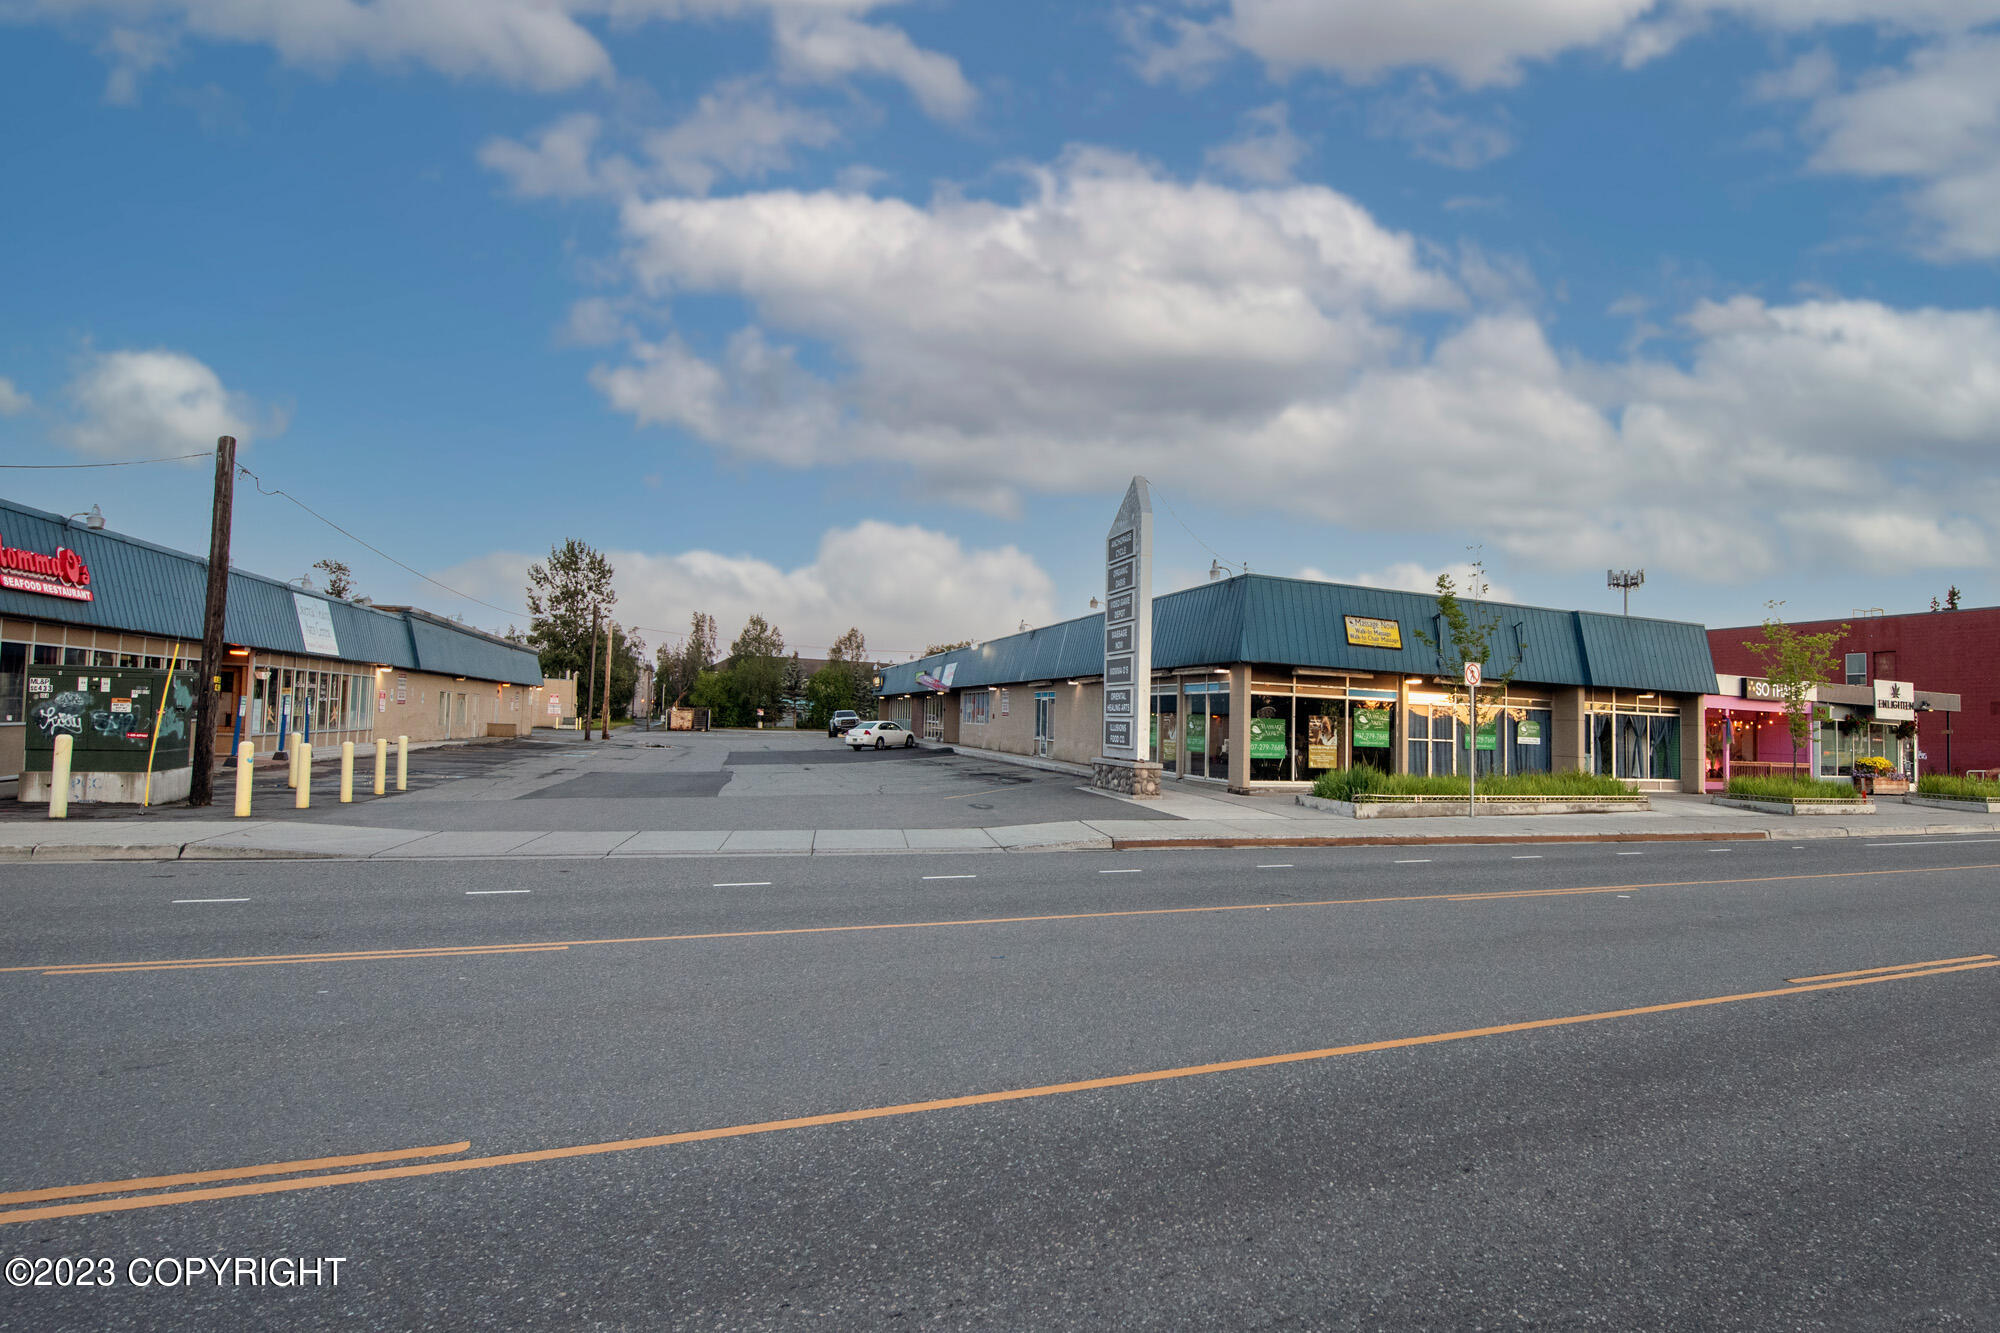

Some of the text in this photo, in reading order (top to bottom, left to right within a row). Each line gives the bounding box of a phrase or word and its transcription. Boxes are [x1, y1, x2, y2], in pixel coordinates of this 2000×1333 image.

[3, 576, 91, 600] SEAFOOD RESTAURANT
[1355, 619, 1379, 629] Massage
[1755, 682, 1770, 697] SO
[1877, 699, 1914, 711] ENLIGHTEN
